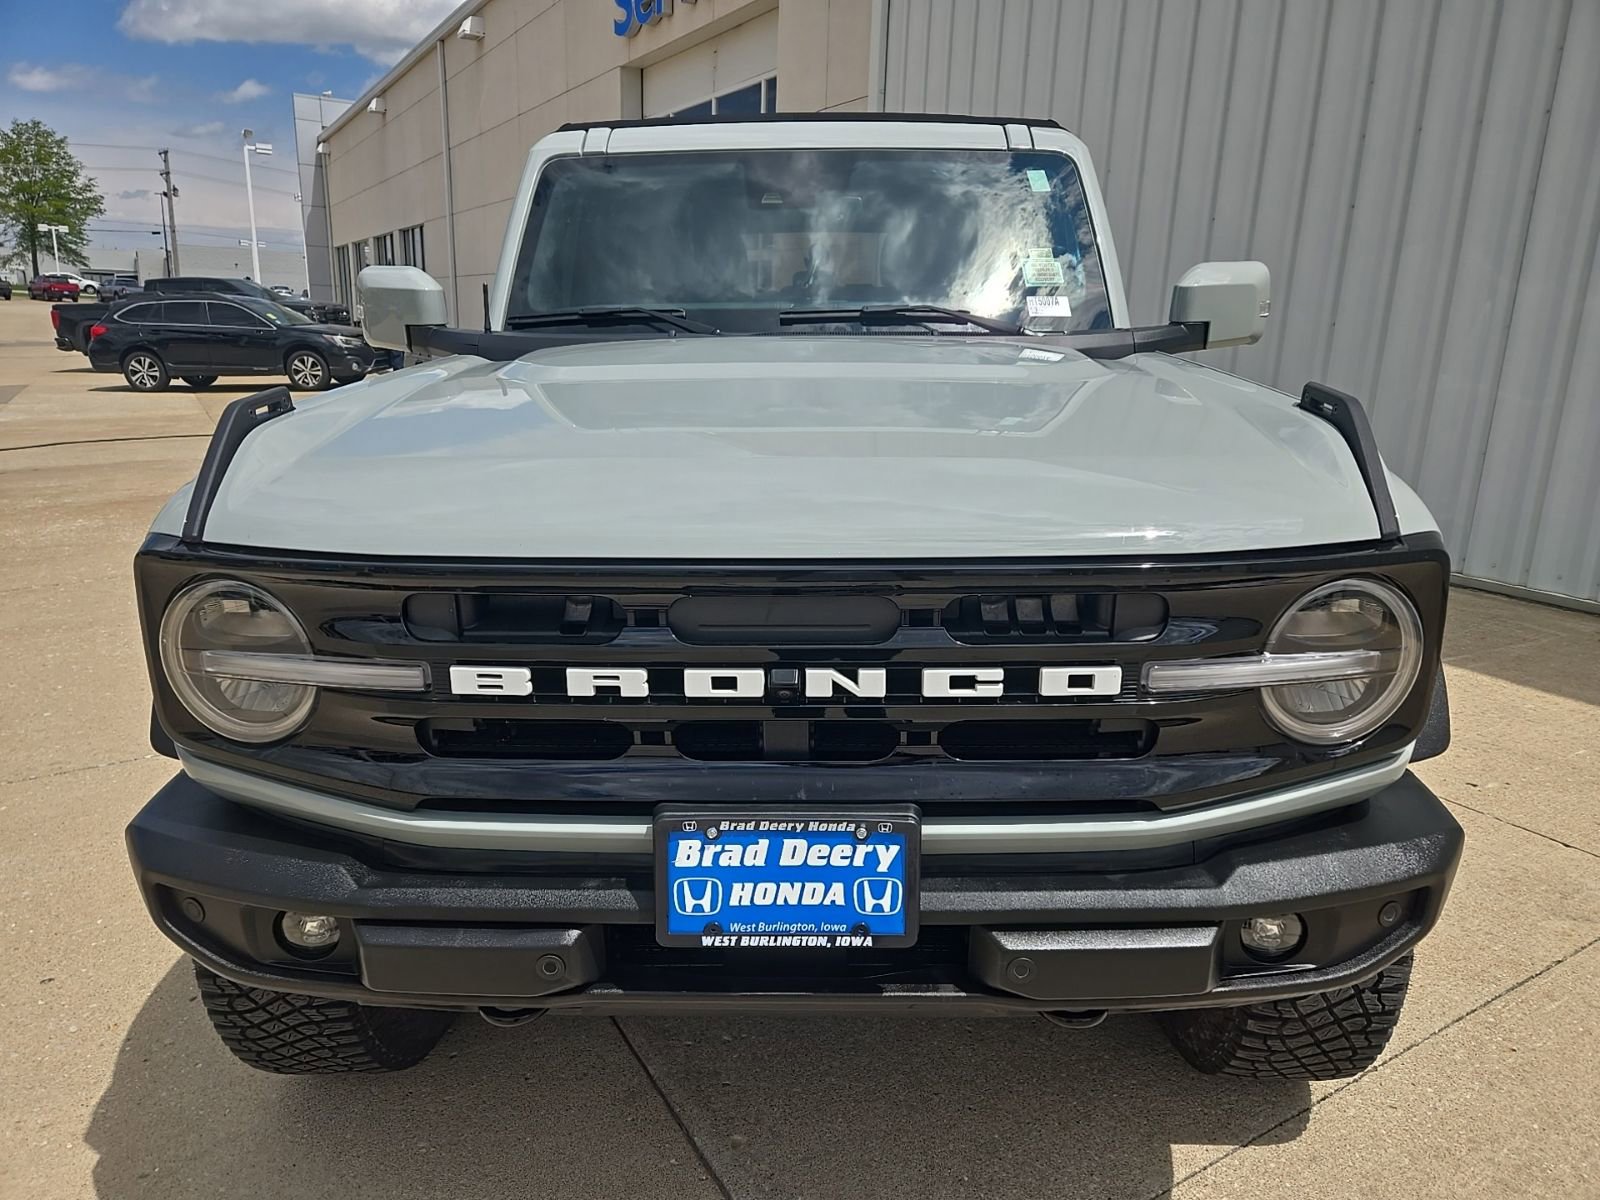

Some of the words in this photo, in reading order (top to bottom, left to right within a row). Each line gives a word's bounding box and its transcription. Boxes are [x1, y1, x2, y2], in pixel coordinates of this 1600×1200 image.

[449, 665, 1123, 698] BRONCO
[719, 821, 756, 831] Brad
[759, 821, 805, 833] Deery
[807, 821, 856, 832] Honda
[674, 838, 769, 867] Brad
[778, 838, 900, 873] Deery
[729, 882, 846, 906] HONDA
[730, 922, 755, 932] West
[758, 921, 818, 934] Burlington,
[821, 922, 847, 932] Iowa
[701, 936, 738, 947] WEST
[740, 936, 832, 948] BURLINGTON,
[835, 935, 873, 947] IOWA
